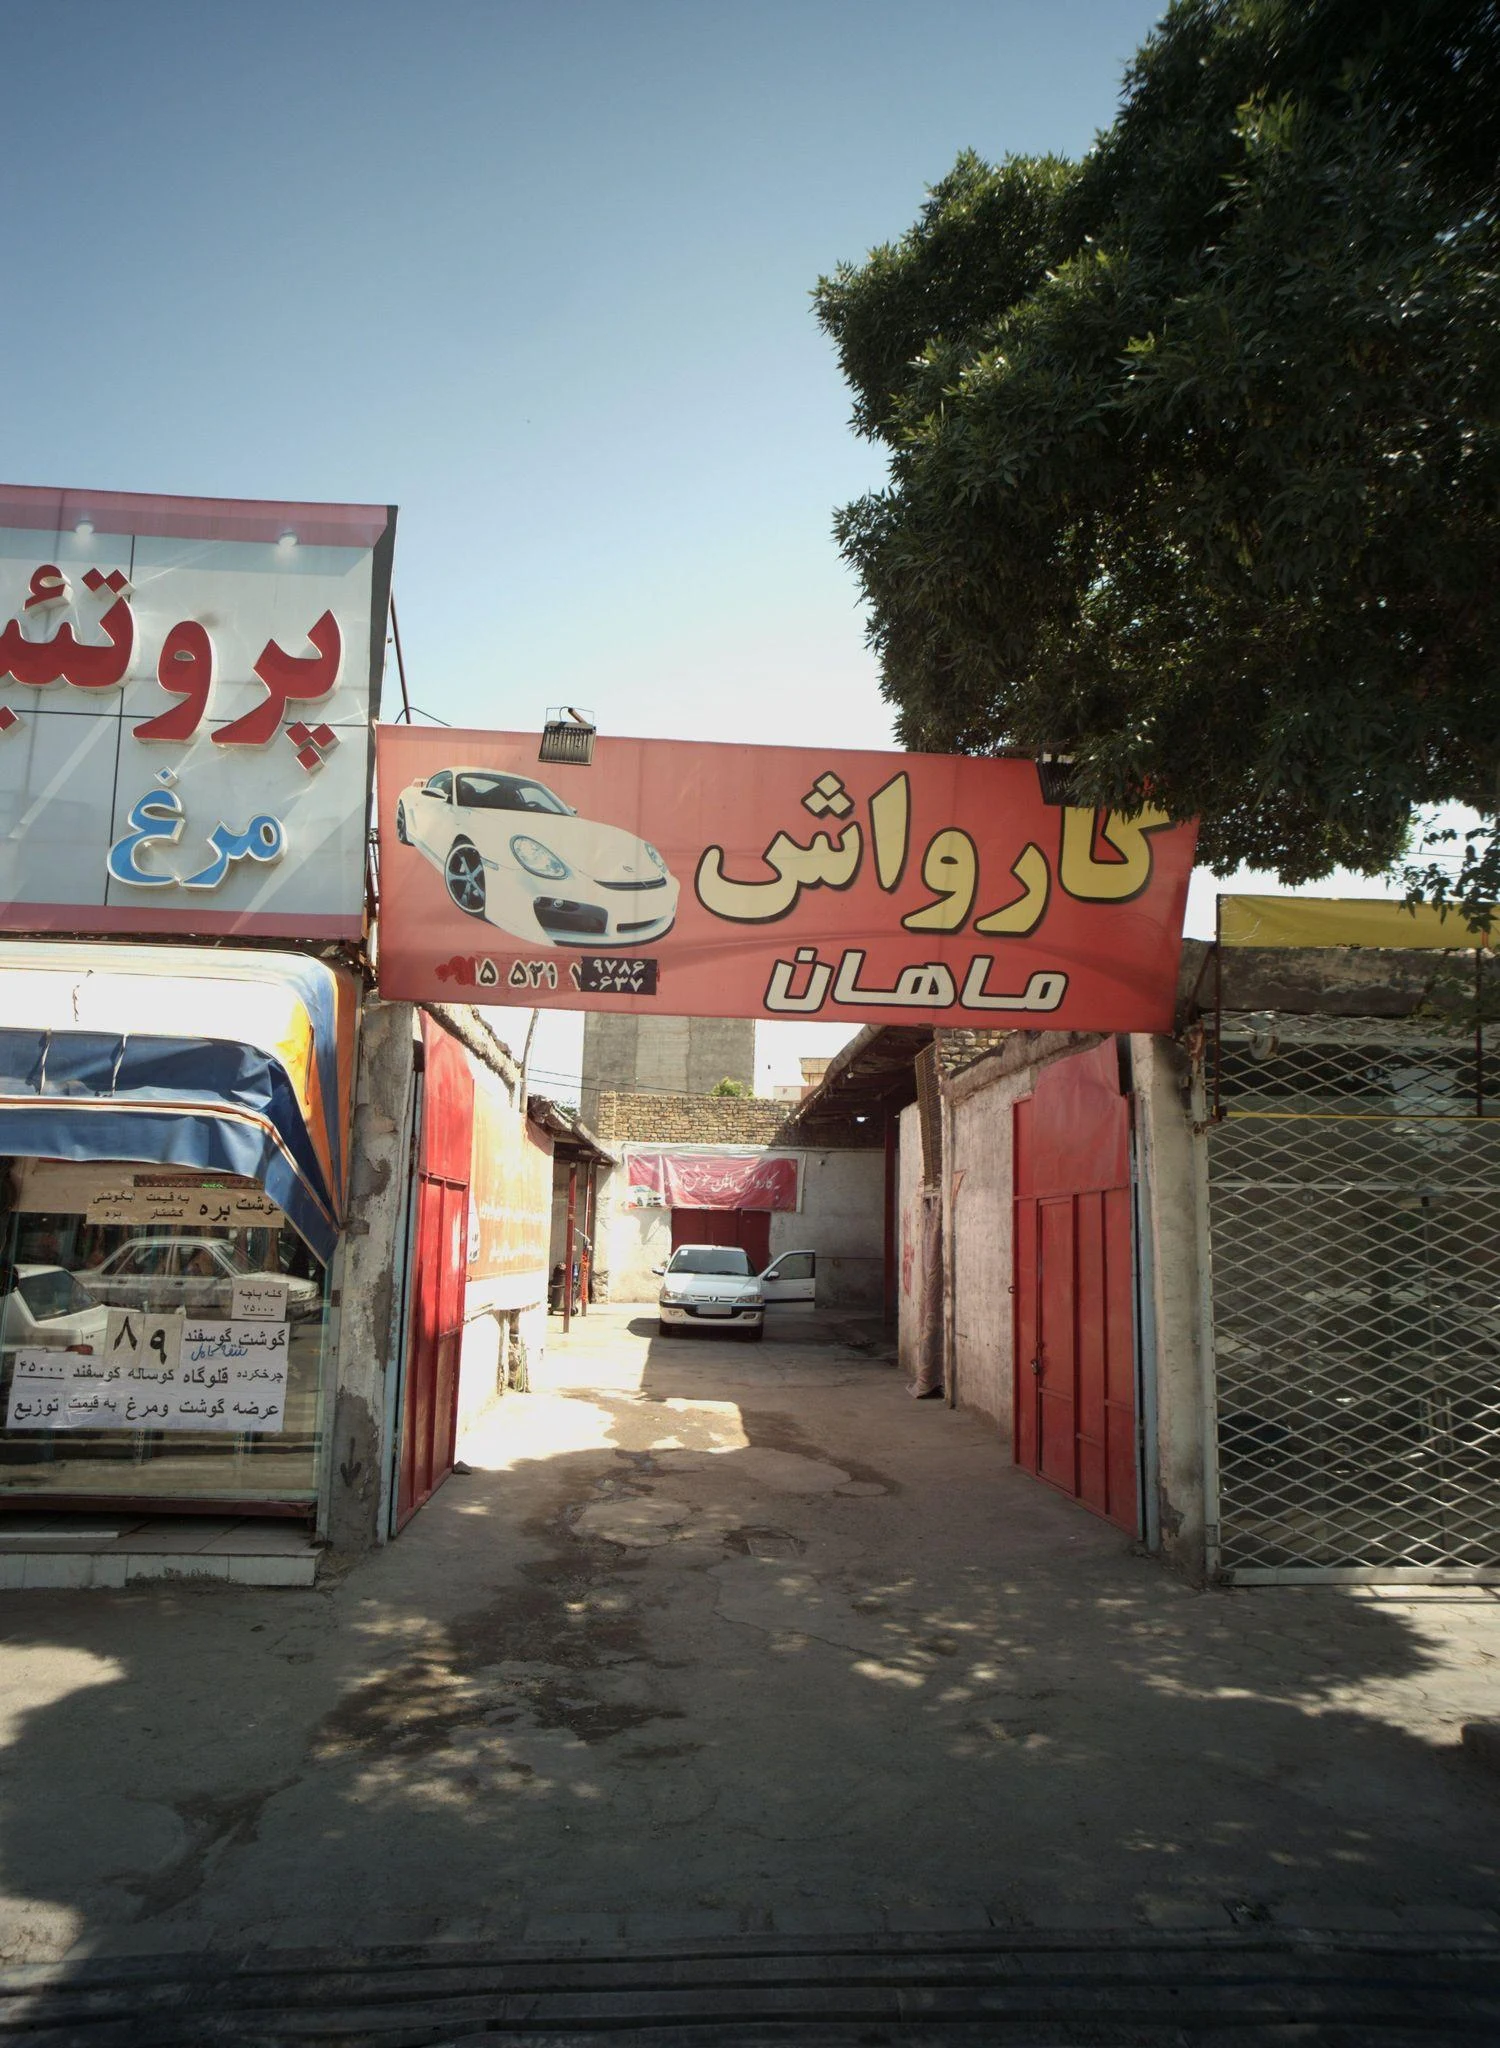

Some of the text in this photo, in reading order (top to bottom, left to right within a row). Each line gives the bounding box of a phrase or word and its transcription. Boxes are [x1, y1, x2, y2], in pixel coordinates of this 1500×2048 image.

[0, 564, 343, 773] پروتئی
[107, 766, 287, 889] مرغ
[592, 959, 646, 976] ۹۷۸۶
[589, 976, 645, 993] ۰۶۳۷
[763, 947, 1069, 1013] ماهان
[146, 1191, 191, 1205] به قیمت
[150, 1207, 185, 1220] کشتار
[199, 1203, 231, 1223] بره
[185, 1327, 285, 1350] گوشت گوسفند
[14, 1398, 59, 1420] توزیع
[67, 1395, 99, 1413] قیمت
[103, 1399, 117, 1414] به
[179, 1398, 225, 1418] گوشت
[232, 1401, 280, 1419] عرضه
